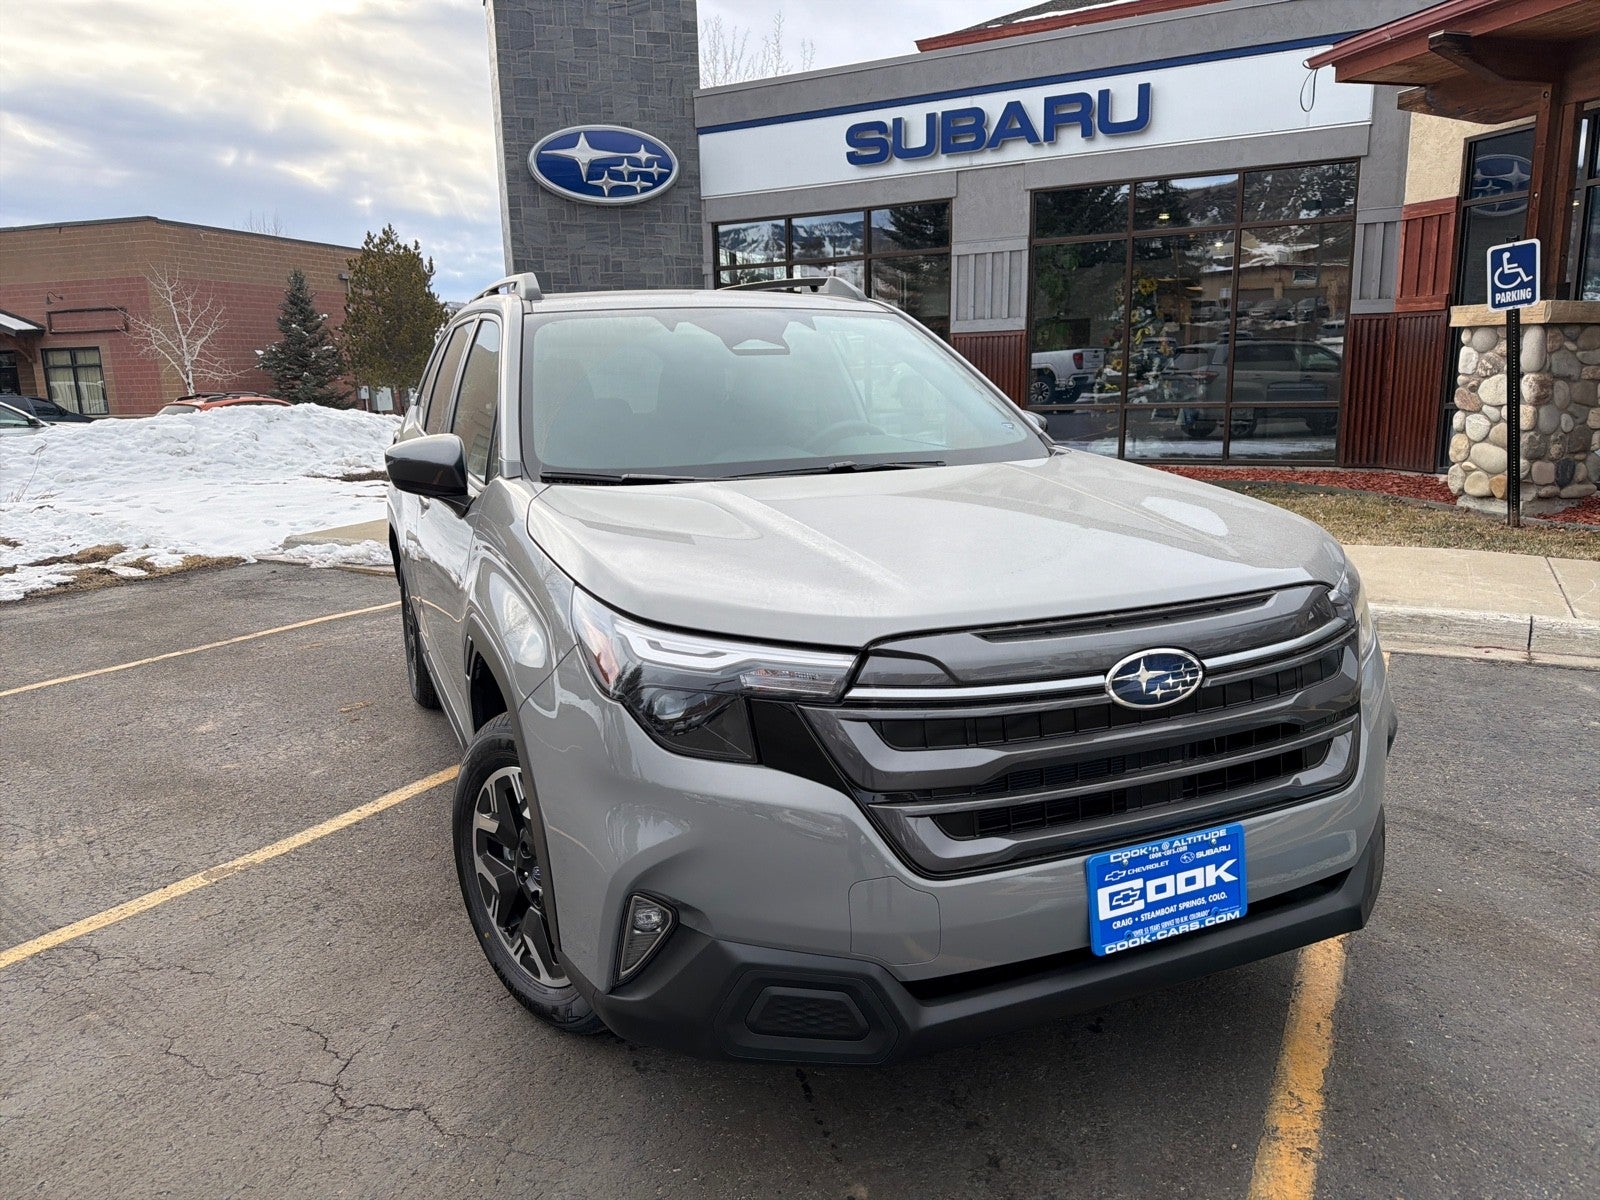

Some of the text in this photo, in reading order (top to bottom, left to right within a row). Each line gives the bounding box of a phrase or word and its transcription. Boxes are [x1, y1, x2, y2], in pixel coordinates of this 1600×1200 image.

[845, 81, 1152, 166] SUBARU
[1495, 287, 1532, 304] PARKING
[1110, 828, 1227, 863] COOK'n @ ALTITUDE
[1195, 843, 1231, 859] SUBARU
[1127, 860, 1170, 875] CHEVROLET
[1097, 858, 1239, 921] COOK
[1112, 917, 1133, 930] CRAIG
[1140, 904, 1178, 922] STEAMBOAT
[1178, 896, 1207, 911] SPRINGS,
[1208, 891, 1228, 902] COLO.
[1104, 909, 1240, 955] COOK-CARS.COM
